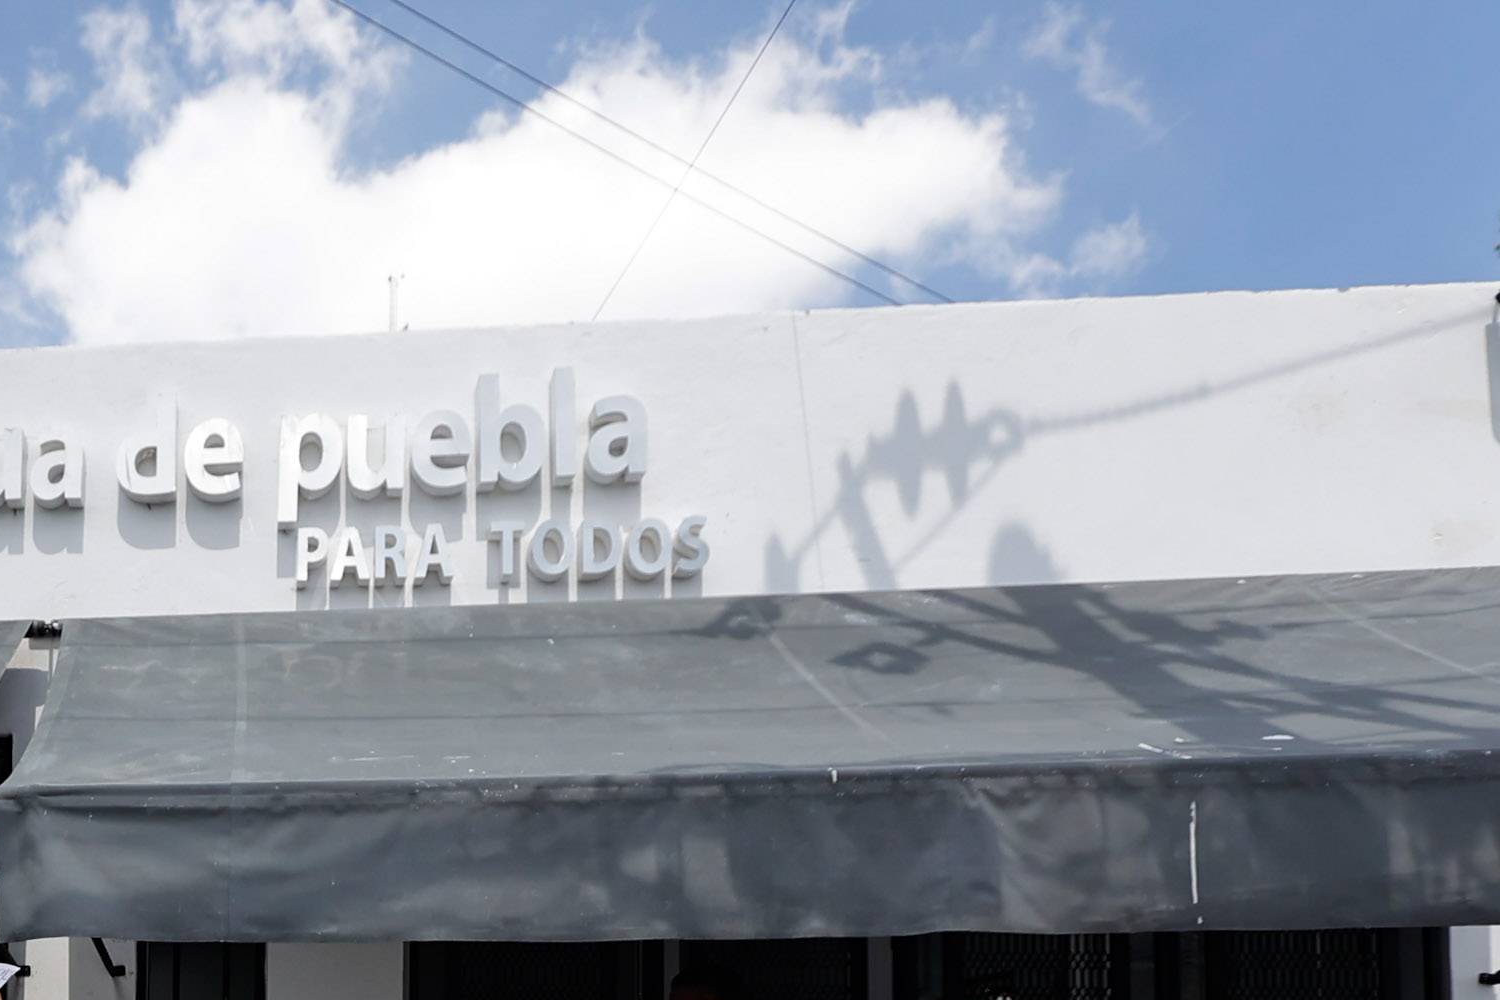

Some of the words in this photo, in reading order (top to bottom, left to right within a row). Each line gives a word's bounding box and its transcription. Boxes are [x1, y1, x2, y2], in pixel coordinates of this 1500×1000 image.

[116, 392, 244, 503] de
[276, 366, 649, 528] puebla
[297, 522, 455, 588] PARA
[489, 514, 710, 582] TODOS
